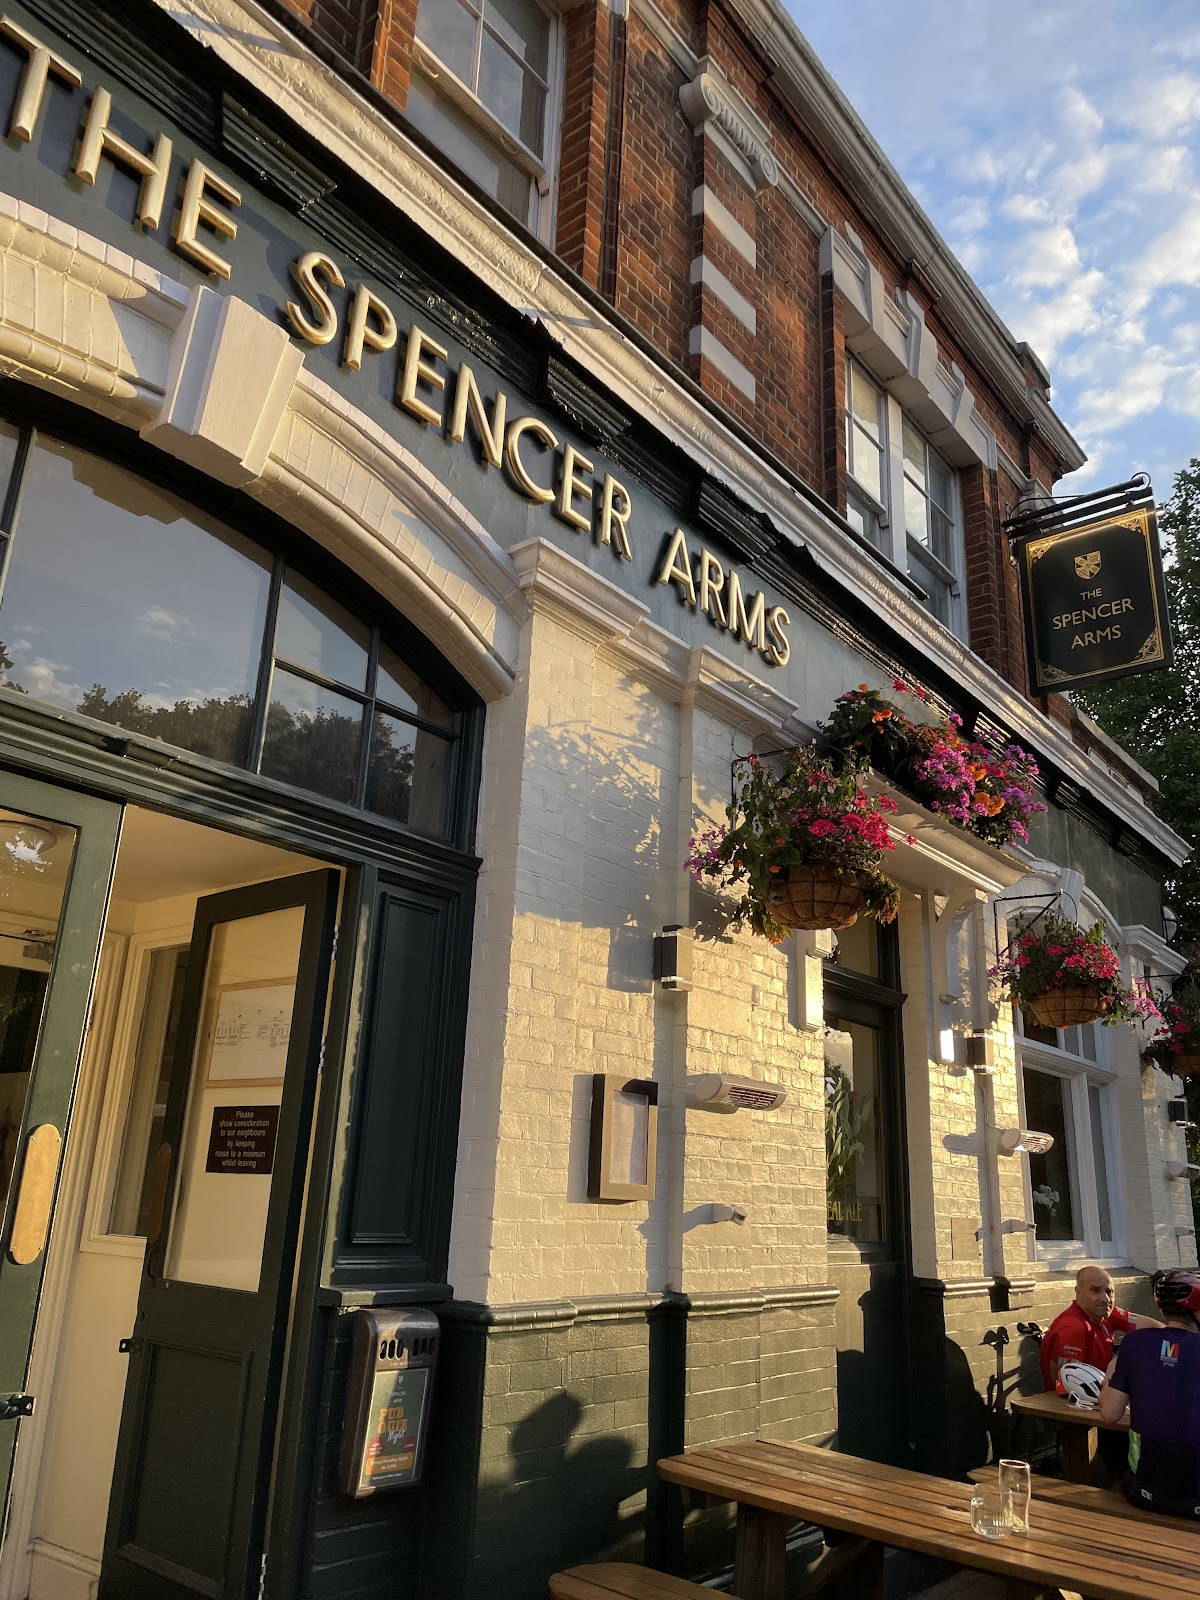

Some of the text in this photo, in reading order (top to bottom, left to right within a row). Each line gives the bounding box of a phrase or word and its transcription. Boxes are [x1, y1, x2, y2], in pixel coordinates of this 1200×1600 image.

[1, 14, 791, 667] THE SPENCER ARMS
[1079, 588, 1103, 601] THE
[1053, 598, 1135, 630] SPENCER
[1071, 625, 1122, 650] ARMS
[235, 1110, 254, 1119] Please
[219, 1119, 270, 1127] show consideration
[220, 1129, 226, 1137] to
[236, 1129, 266, 1138] neighbours
[227, 1139, 256, 1149] by keeping
[215, 1150, 230, 1158] noise
[230, 1150, 237, 1158] to
[242, 1150, 266, 1158] minimum
[221, 1159, 257, 1169] whilst leaving
[827, 1200, 863, 1222] EAL ALE
[379, 1407, 405, 1421] PUB
[377, 1418, 409, 1434] QUIZ
[387, 1430, 405, 1444] Night
